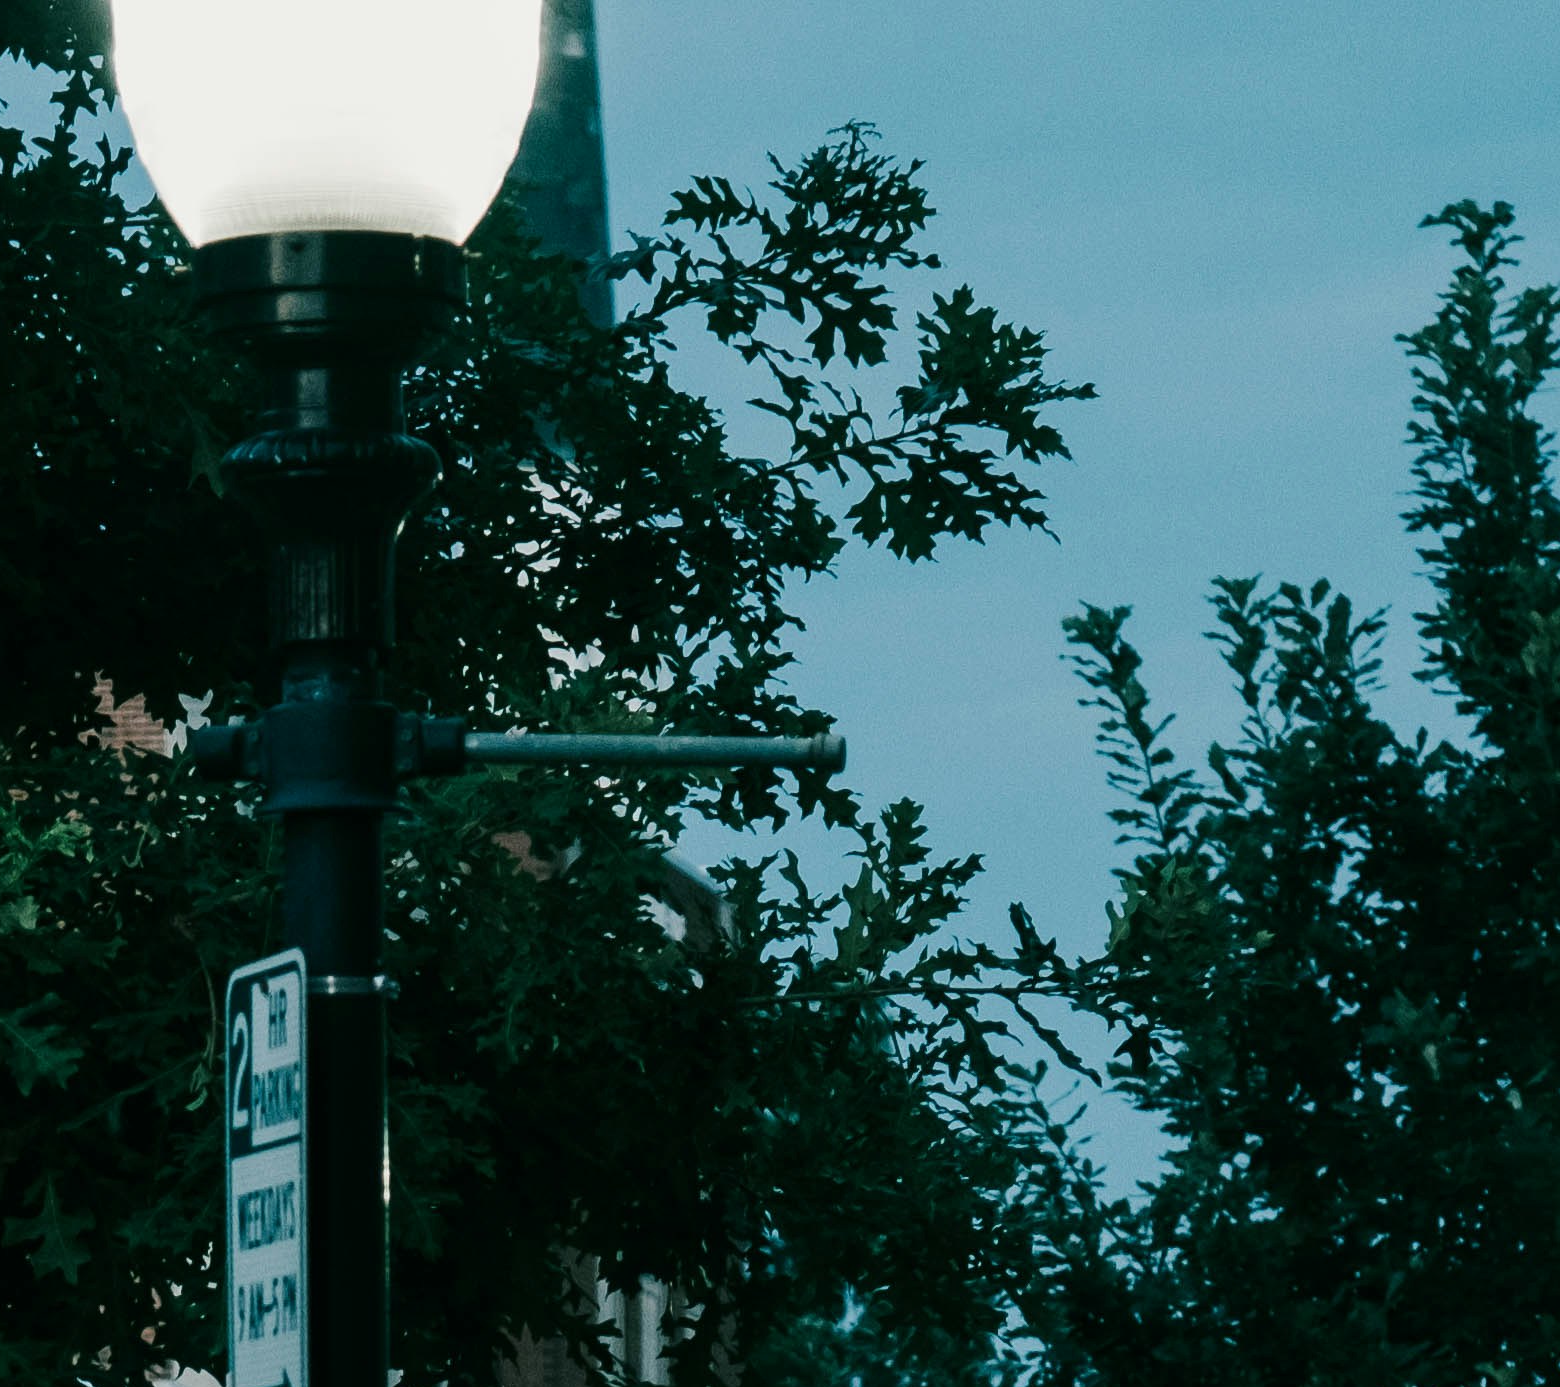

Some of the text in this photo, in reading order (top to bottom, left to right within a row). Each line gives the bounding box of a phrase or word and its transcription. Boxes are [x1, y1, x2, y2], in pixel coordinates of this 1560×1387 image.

[232, 988, 288, 1130] 2 HR
[252, 1062, 302, 1131] PARKING
